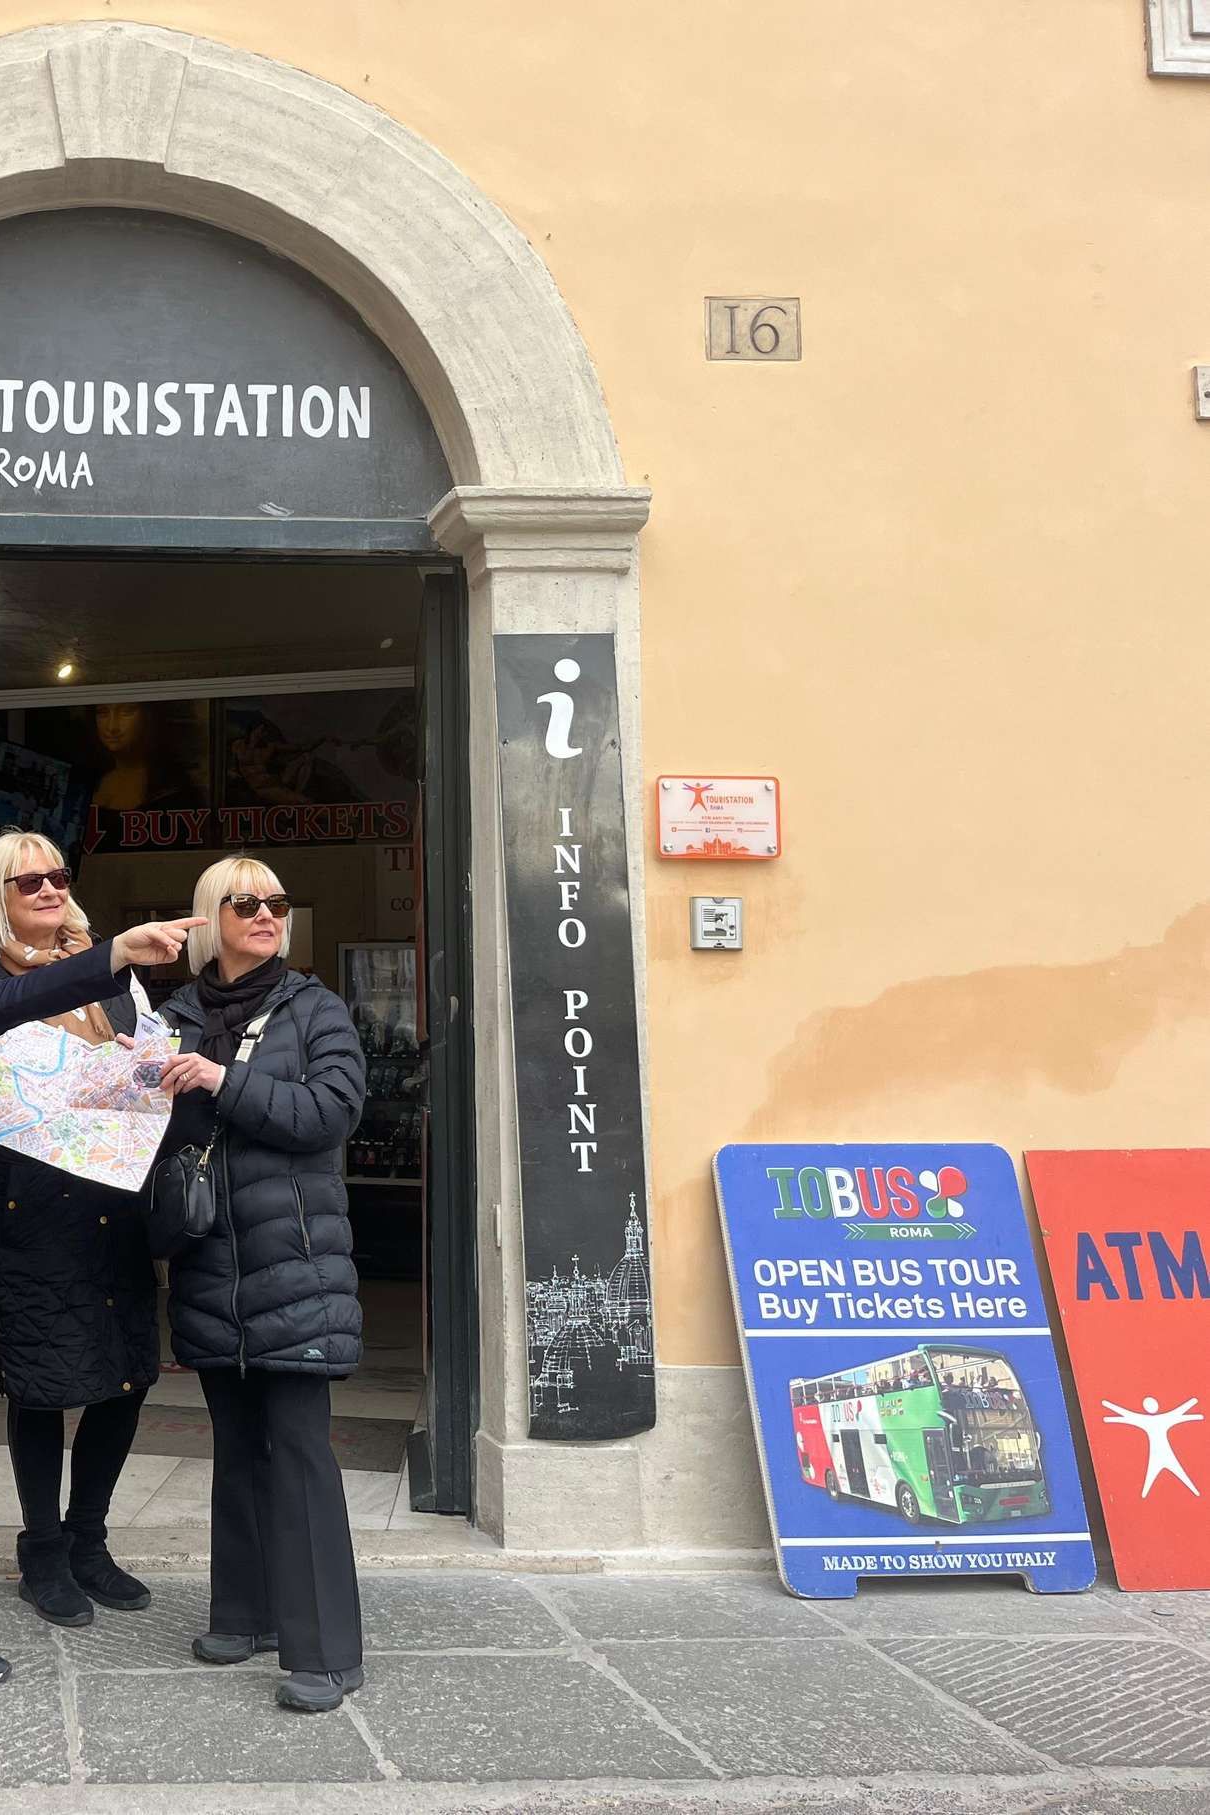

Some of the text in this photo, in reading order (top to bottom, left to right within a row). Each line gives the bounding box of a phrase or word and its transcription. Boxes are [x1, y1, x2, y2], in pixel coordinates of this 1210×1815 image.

[723, 305, 787, 354] 16
[706, 795, 754, 804] TOURISTATION
[120, 801, 411, 847] BUY TICKETS
[553, 807, 597, 1173] INFO POINT
[766, 1166, 921, 1219] IOBUS
[889, 1226, 933, 1238] ROMA
[754, 1258, 1021, 1288] OPEN BUS TOUR
[1076, 1231, 1210, 1300] ATM
[758, 1291, 1028, 1324] Buy Tickets Here
[823, 1552, 1056, 1572] MADE TO SHOW YOU ITALY
